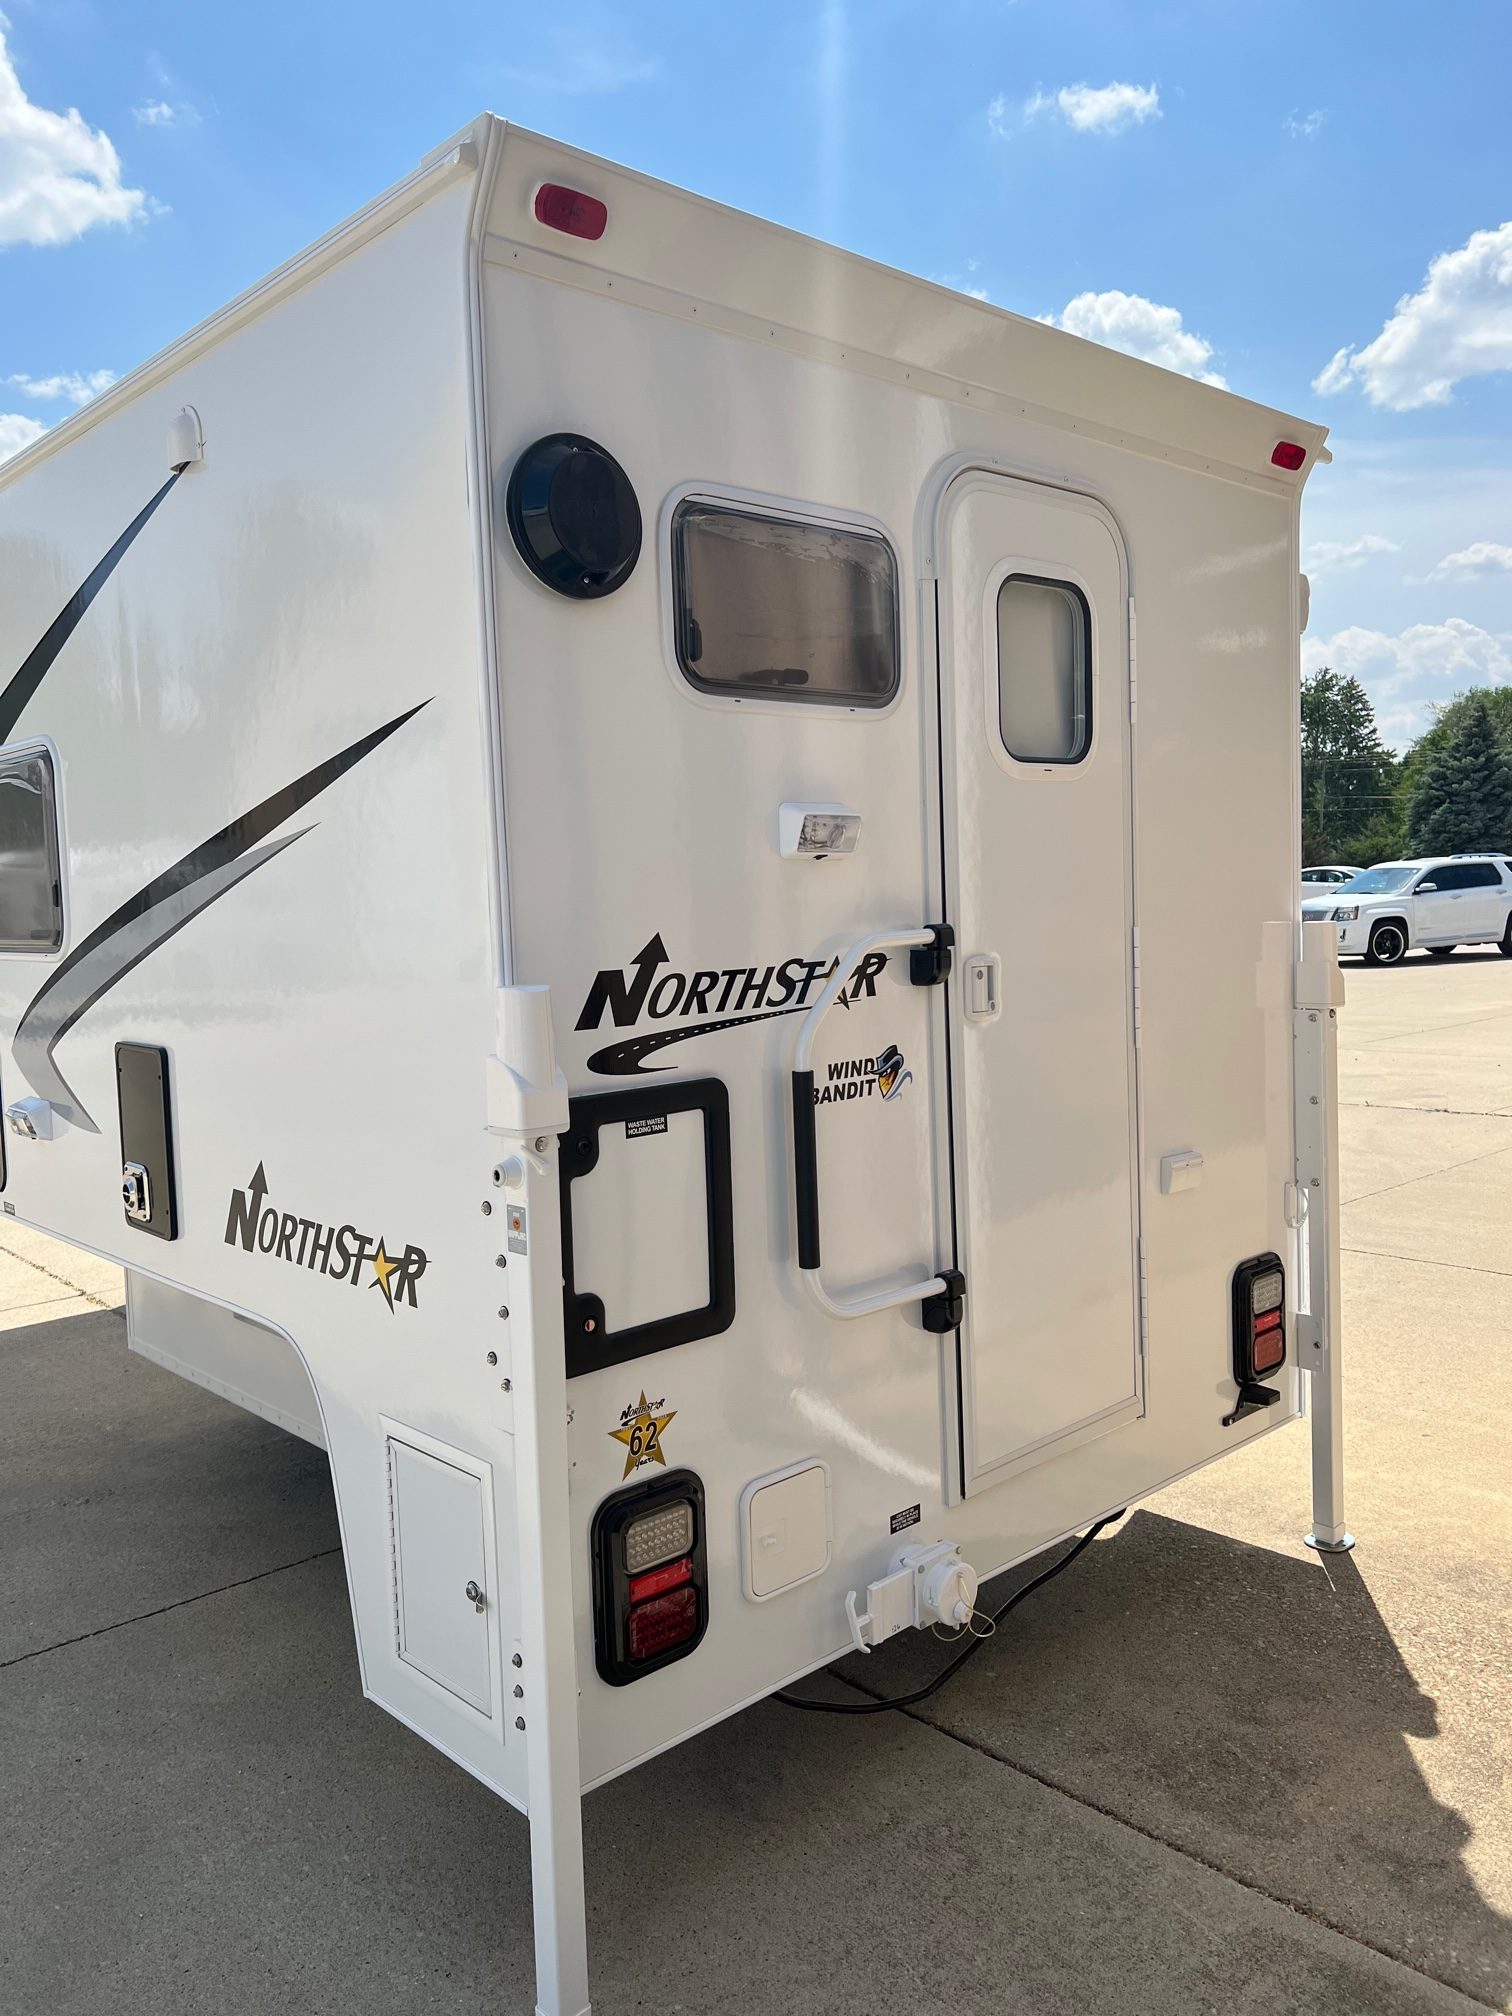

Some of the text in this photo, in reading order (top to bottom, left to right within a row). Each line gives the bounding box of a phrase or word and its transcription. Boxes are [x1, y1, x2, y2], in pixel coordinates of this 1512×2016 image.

[827, 1058, 877, 1081] WIND
[628, 1117, 665, 1128] WASTE WATER
[628, 1126, 651, 1135] HOLDING
[224, 1160, 430, 1313] NORTHSTAR
[620, 1398, 665, 1420] NORTHSTAR
[629, 1421, 658, 1456] 62
[634, 1456, 654, 1470] Years
